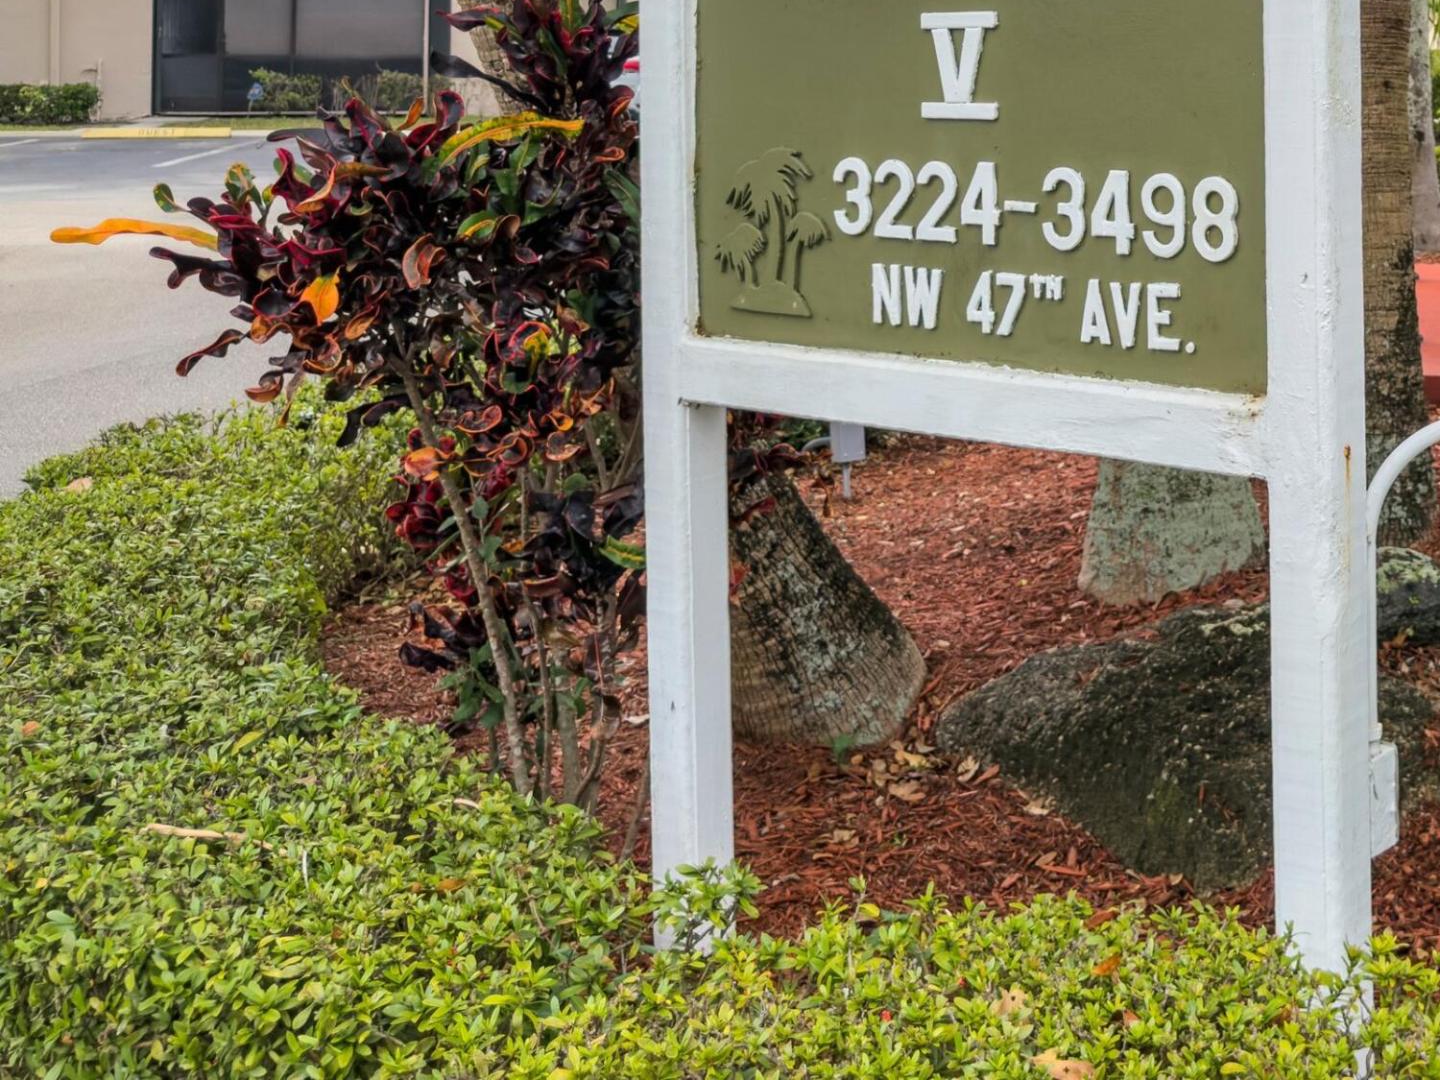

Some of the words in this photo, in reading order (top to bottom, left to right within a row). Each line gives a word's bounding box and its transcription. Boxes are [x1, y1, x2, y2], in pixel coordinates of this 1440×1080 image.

[920, 11, 999, 120] V
[832, 157, 1239, 262] 3224-3498
[871, 263, 943, 330] NW
[1080, 279, 1196, 354] AVE.
